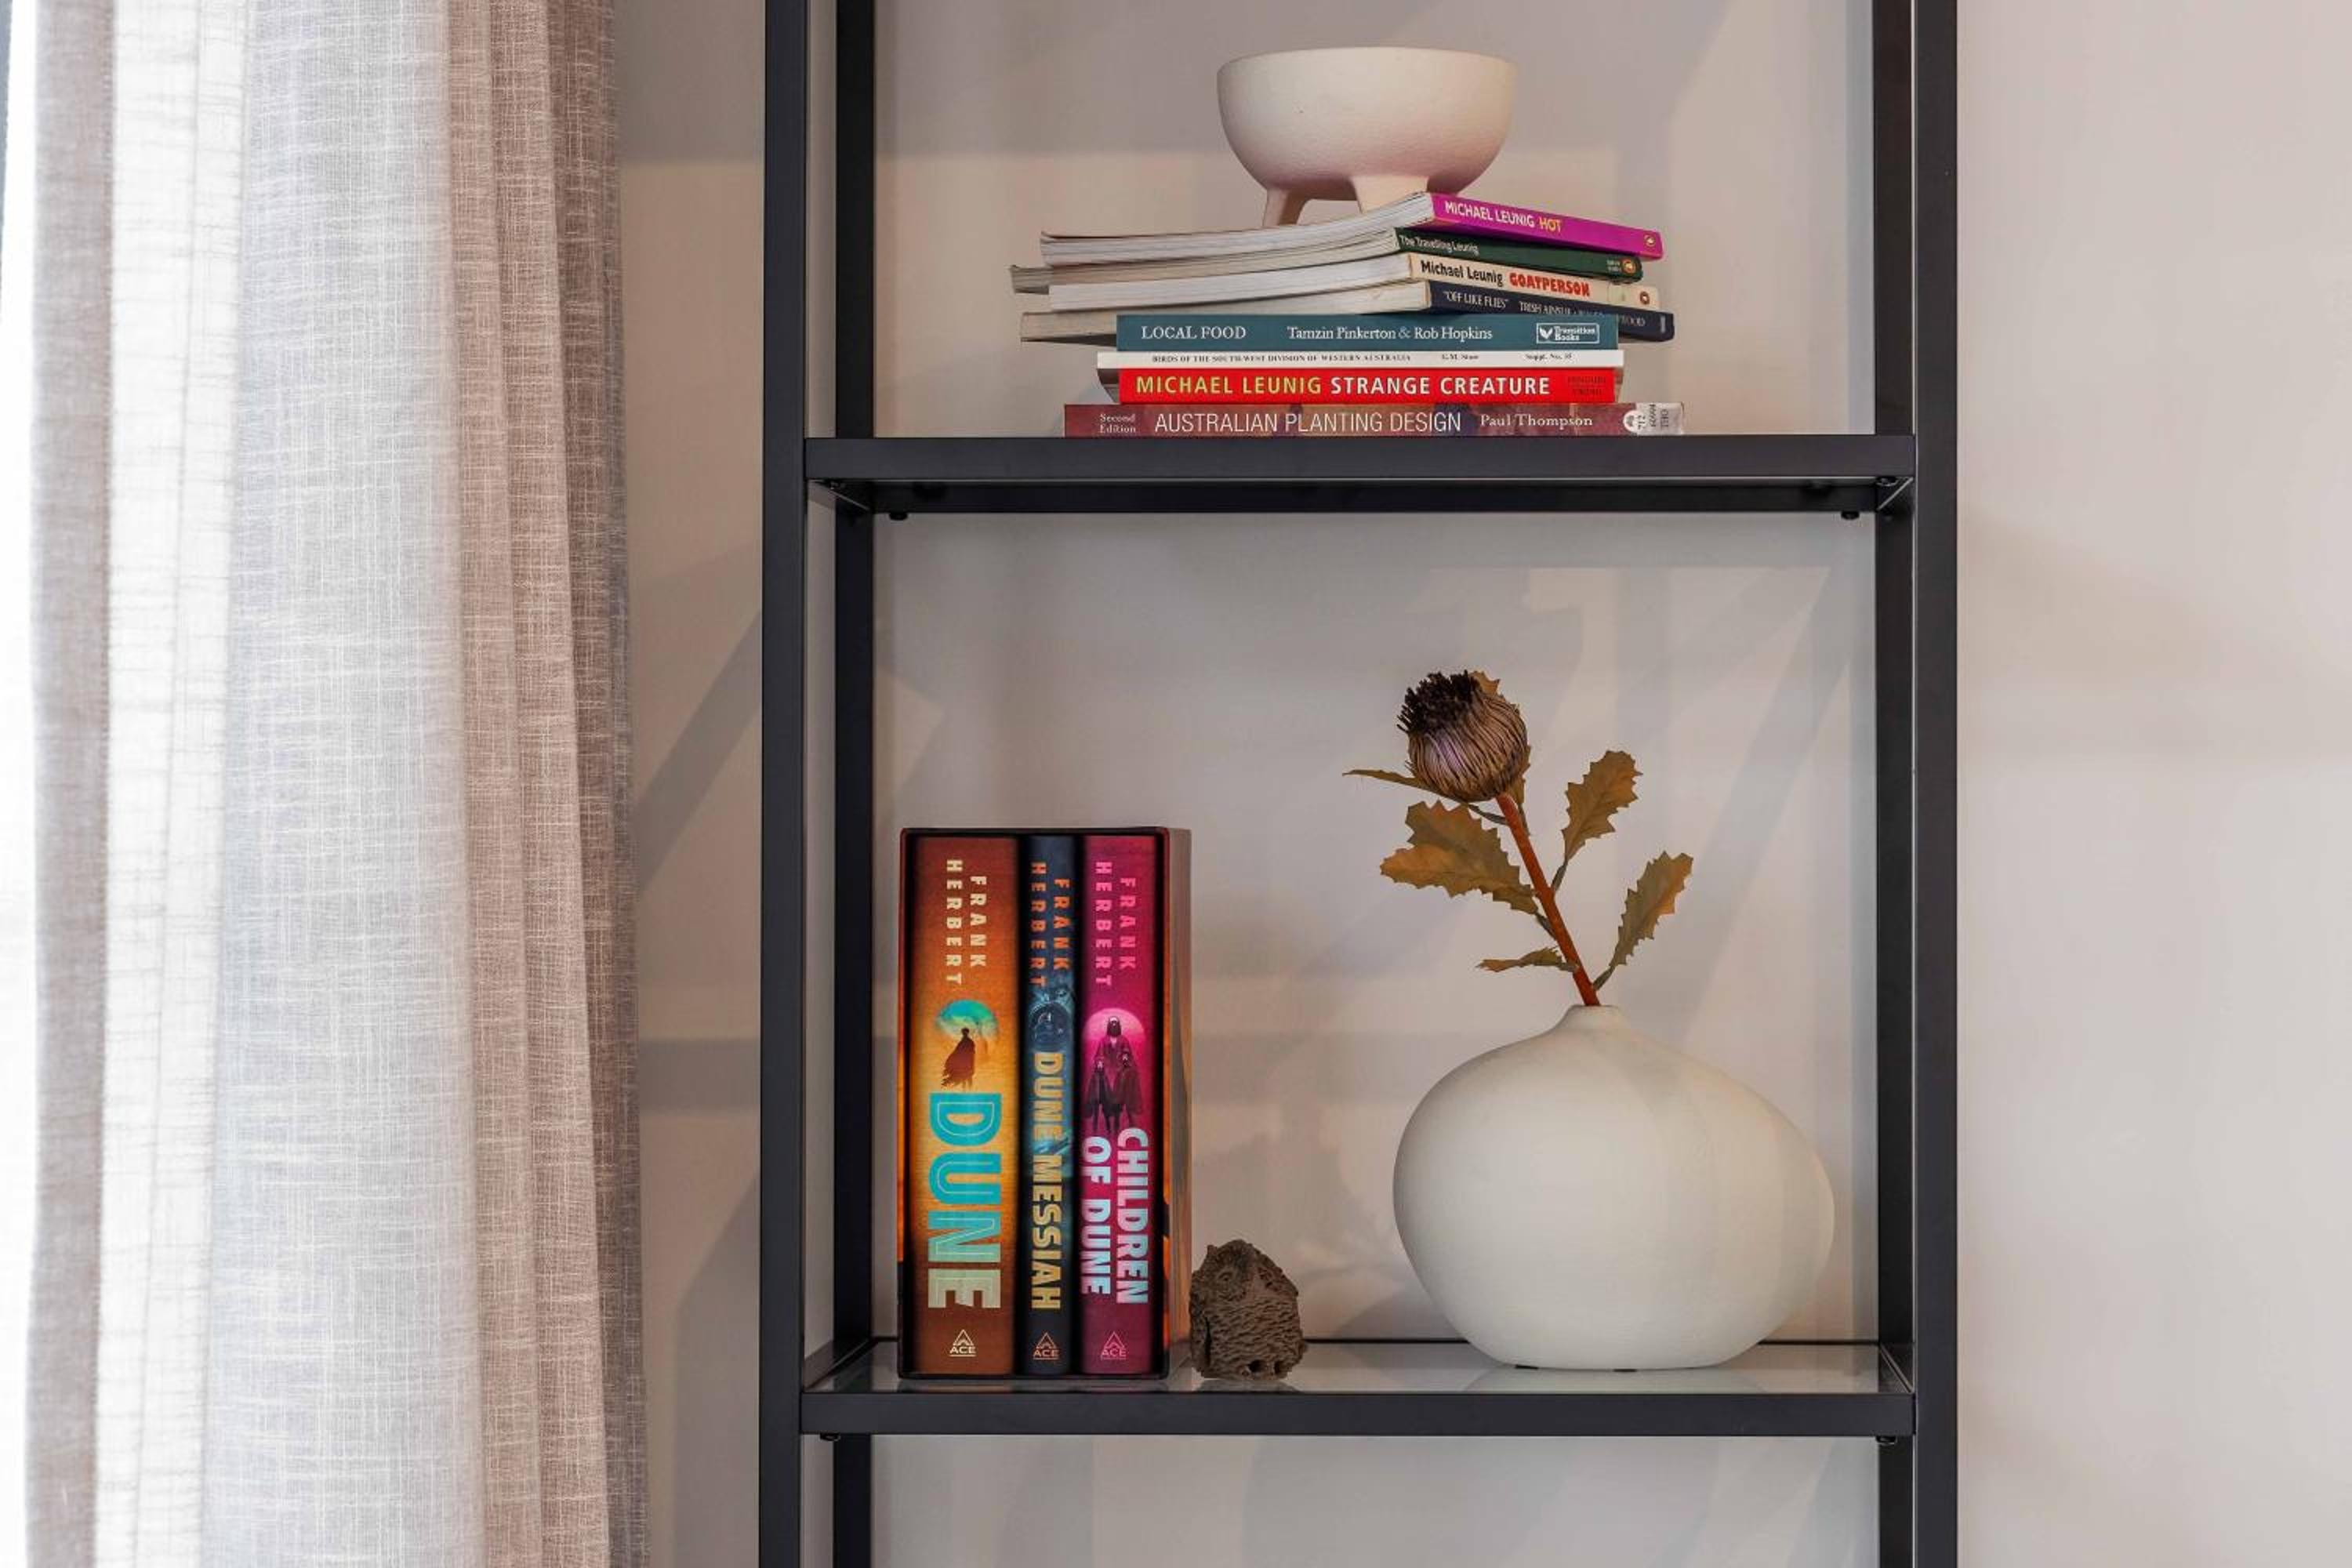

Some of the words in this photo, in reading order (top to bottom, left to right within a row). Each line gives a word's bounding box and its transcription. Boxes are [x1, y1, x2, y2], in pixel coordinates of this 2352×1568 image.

[1445, 200, 1493, 221] MICHAEL
[1495, 210, 1535, 228] LEUNIG
[1539, 216, 1562, 233] HOT
[1400, 235, 1415, 248] The
[1421, 260, 1464, 279] Michael
[1467, 267, 1503, 287] Leunig
[1509, 272, 1591, 296] GOATPERSON
[1464, 292, 1483, 305] LIKE
[1142, 325, 1196, 339] LOCAL
[1200, 326, 1247, 339] FOOD
[1287, 326, 1334, 339] Tamzin
[1336, 326, 1396, 339] Pinkerton
[1398, 327, 1410, 339] &
[1414, 327, 1439, 339] Rob
[1441, 326, 1493, 343] Hopkins
[1136, 376, 1233, 394] MICHAEL
[1242, 376, 1322, 394] LEUNIG
[1330, 376, 1430, 394] STRANGE
[1439, 376, 1550, 394] CREATURE
[1099, 423, 1136, 434] Edition
[1100, 413, 1136, 423] Second
[1155, 412, 1277, 433] AUSTRALIAN
[1285, 412, 1383, 433] PLANTING
[1390, 412, 1461, 432] DESIGN
[1480, 414, 1511, 427] Paul
[1515, 413, 1593, 430] Thompson
[946, 859, 964, 985] HERBERT
[970, 876, 987, 967] FRANK
[1030, 862, 1047, 988] HERBERT
[1053, 879, 1070, 970] FRANK
[1095, 861, 1112, 985] HERBERT
[1120, 877, 1136, 969] FRANK
[1034, 1052, 1063, 1142] DUNE
[1081, 1136, 1112, 1185] OF
[927, 1092, 1003, 1308] DUNE
[1116, 1127, 1149, 1304] CHILDREN
[1031, 1154, 1062, 1309] MESSIAH
[1081, 1199, 1112, 1294] DUNE
[949, 1345, 977, 1355] ACE
[1033, 1349, 1058, 1358] ACE
[1102, 1348, 1127, 1357] ACE
